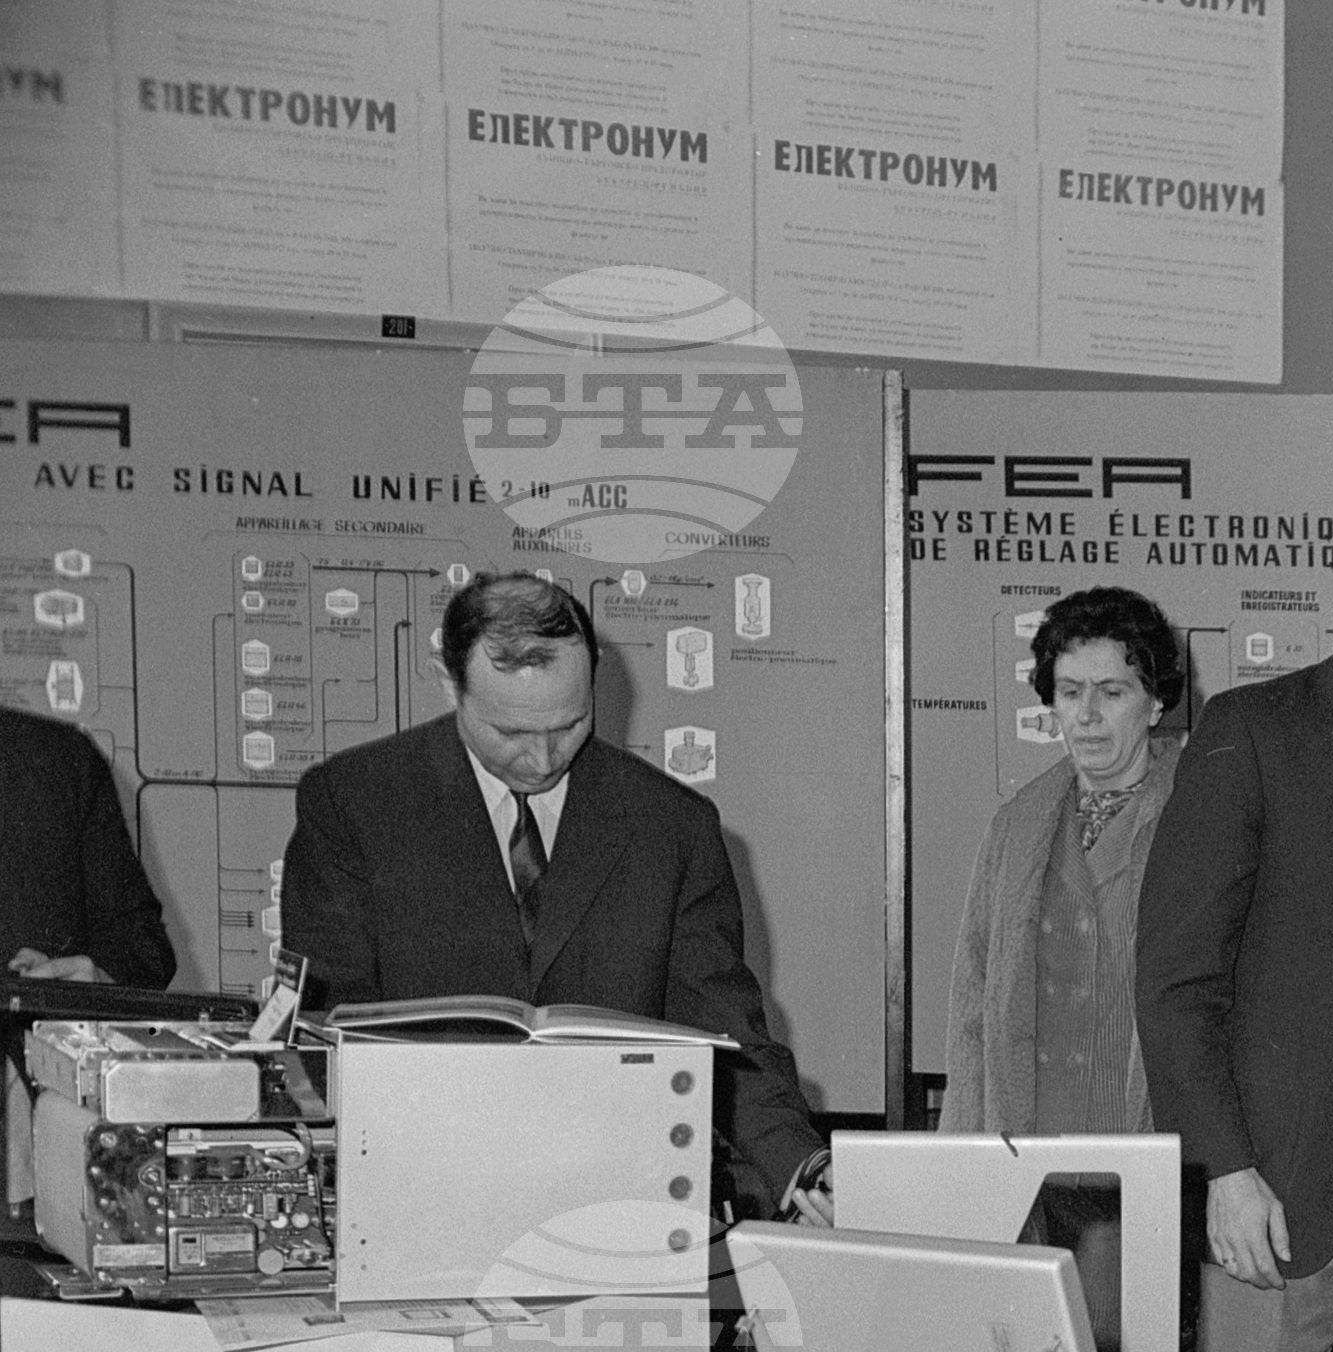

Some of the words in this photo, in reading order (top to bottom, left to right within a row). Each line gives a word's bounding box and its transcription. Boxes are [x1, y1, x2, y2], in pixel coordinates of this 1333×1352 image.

[137, 77, 397, 134] ЕЛЕКТРОНУМ
[467, 107, 708, 163] ЕЛЕКТРОНУМ
[774, 139, 998, 192] ЕЛЕКТРОНУМ
[1059, 168, 1266, 216] ЕЛЕКТРОНУМ
[34, 462, 135, 491] AVEC
[908, 454, 1192, 500] FEA
[909, 508, 1076, 536] SYSTÈME
[910, 538, 947, 561] DE
[974, 535, 1119, 564] RÉGLAGE
